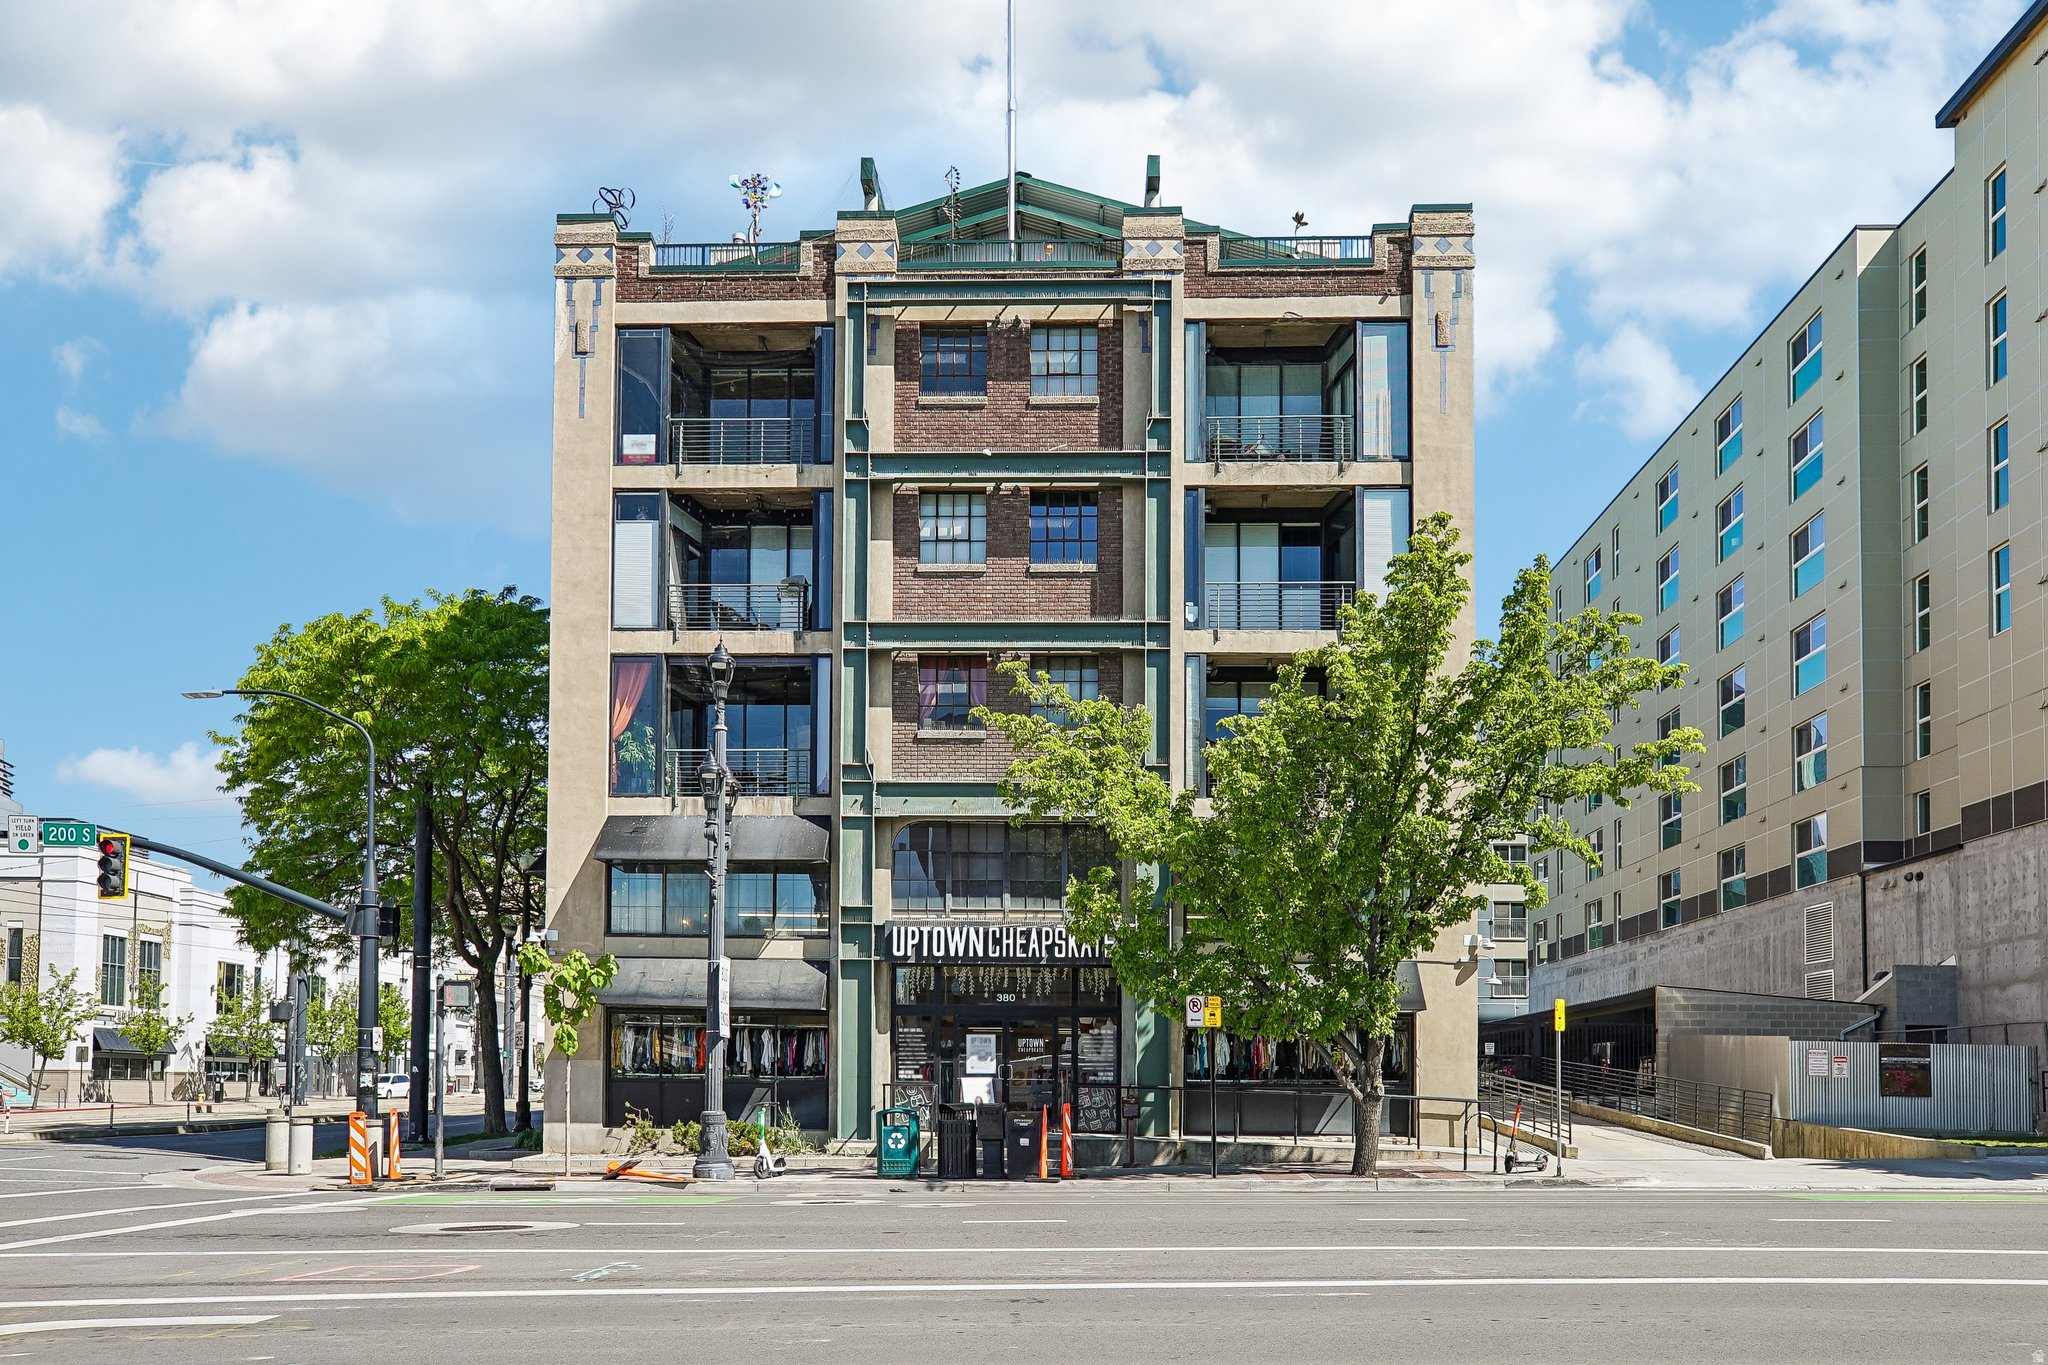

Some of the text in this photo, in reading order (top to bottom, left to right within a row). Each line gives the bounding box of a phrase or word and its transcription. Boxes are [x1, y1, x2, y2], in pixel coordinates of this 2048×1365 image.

[48, 827, 91, 843] 200 S
[892, 926, 984, 957] UPTOWN
[996, 993, 1016, 1002] 380
[515, 1036, 524, 1046] 25
[1017, 1038, 1044, 1048] UPTOWN
